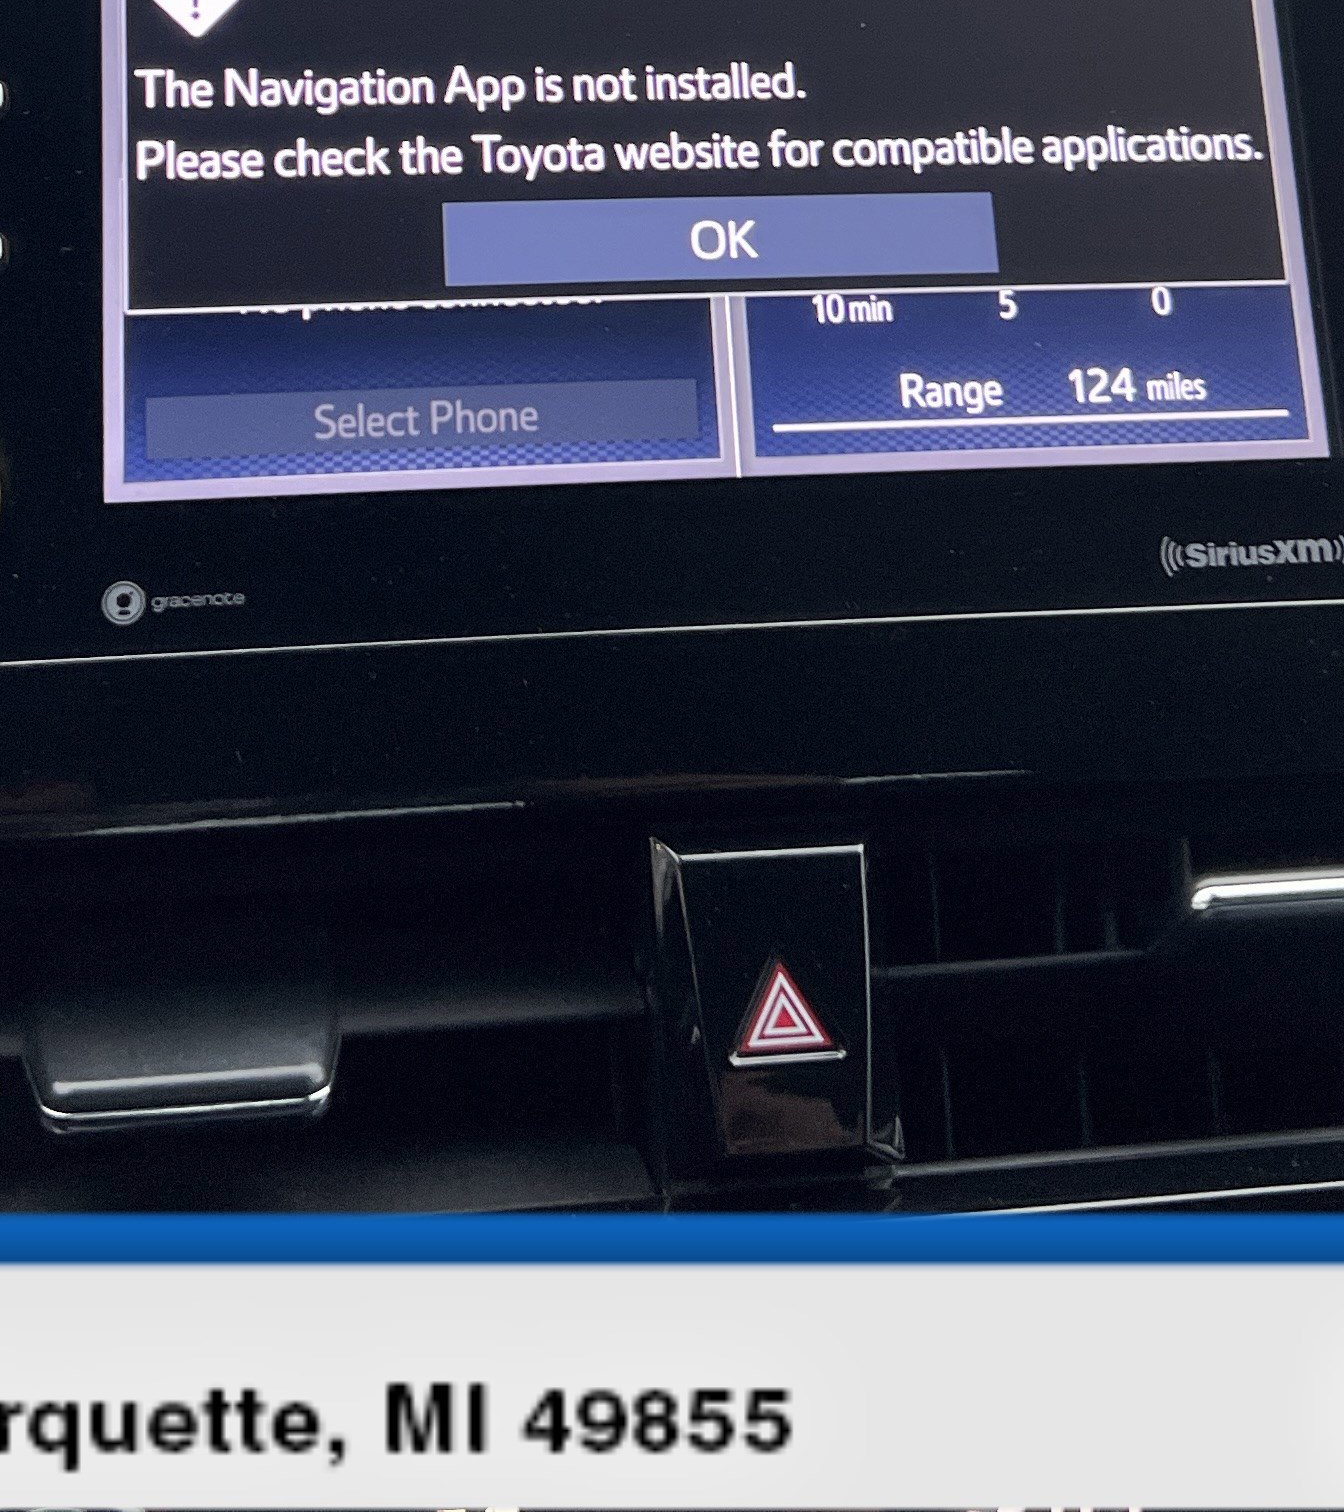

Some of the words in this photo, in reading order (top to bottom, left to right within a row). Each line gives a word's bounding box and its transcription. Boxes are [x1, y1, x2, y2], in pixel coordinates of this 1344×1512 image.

[134, 67, 214, 110] The
[224, 67, 435, 115] Navigation
[444, 65, 526, 112] App
[534, 65, 565, 103] is
[572, 66, 637, 103] not
[644, 60, 807, 102] installed.
[136, 138, 265, 182] Please
[273, 135, 391, 178] check
[399, 134, 464, 176] the
[471, 132, 606, 182] Toyota
[613, 130, 760, 173] website
[767, 128, 825, 169] for
[831, 125, 1036, 175] compatible
[1041, 123, 1265, 172] applications.
[689, 218, 759, 261] OK
[812, 294, 845, 325] 10
[847, 292, 895, 324] min
[997, 289, 1019, 321] 5
[1151, 285, 1173, 317] 0
[899, 372, 1004, 414] Range
[1067, 366, 1138, 404] 124
[1145, 368, 1208, 403] miles
[314, 402, 421, 441] Select
[429, 398, 540, 436] Phone
[151, 591, 246, 613] gracenote
